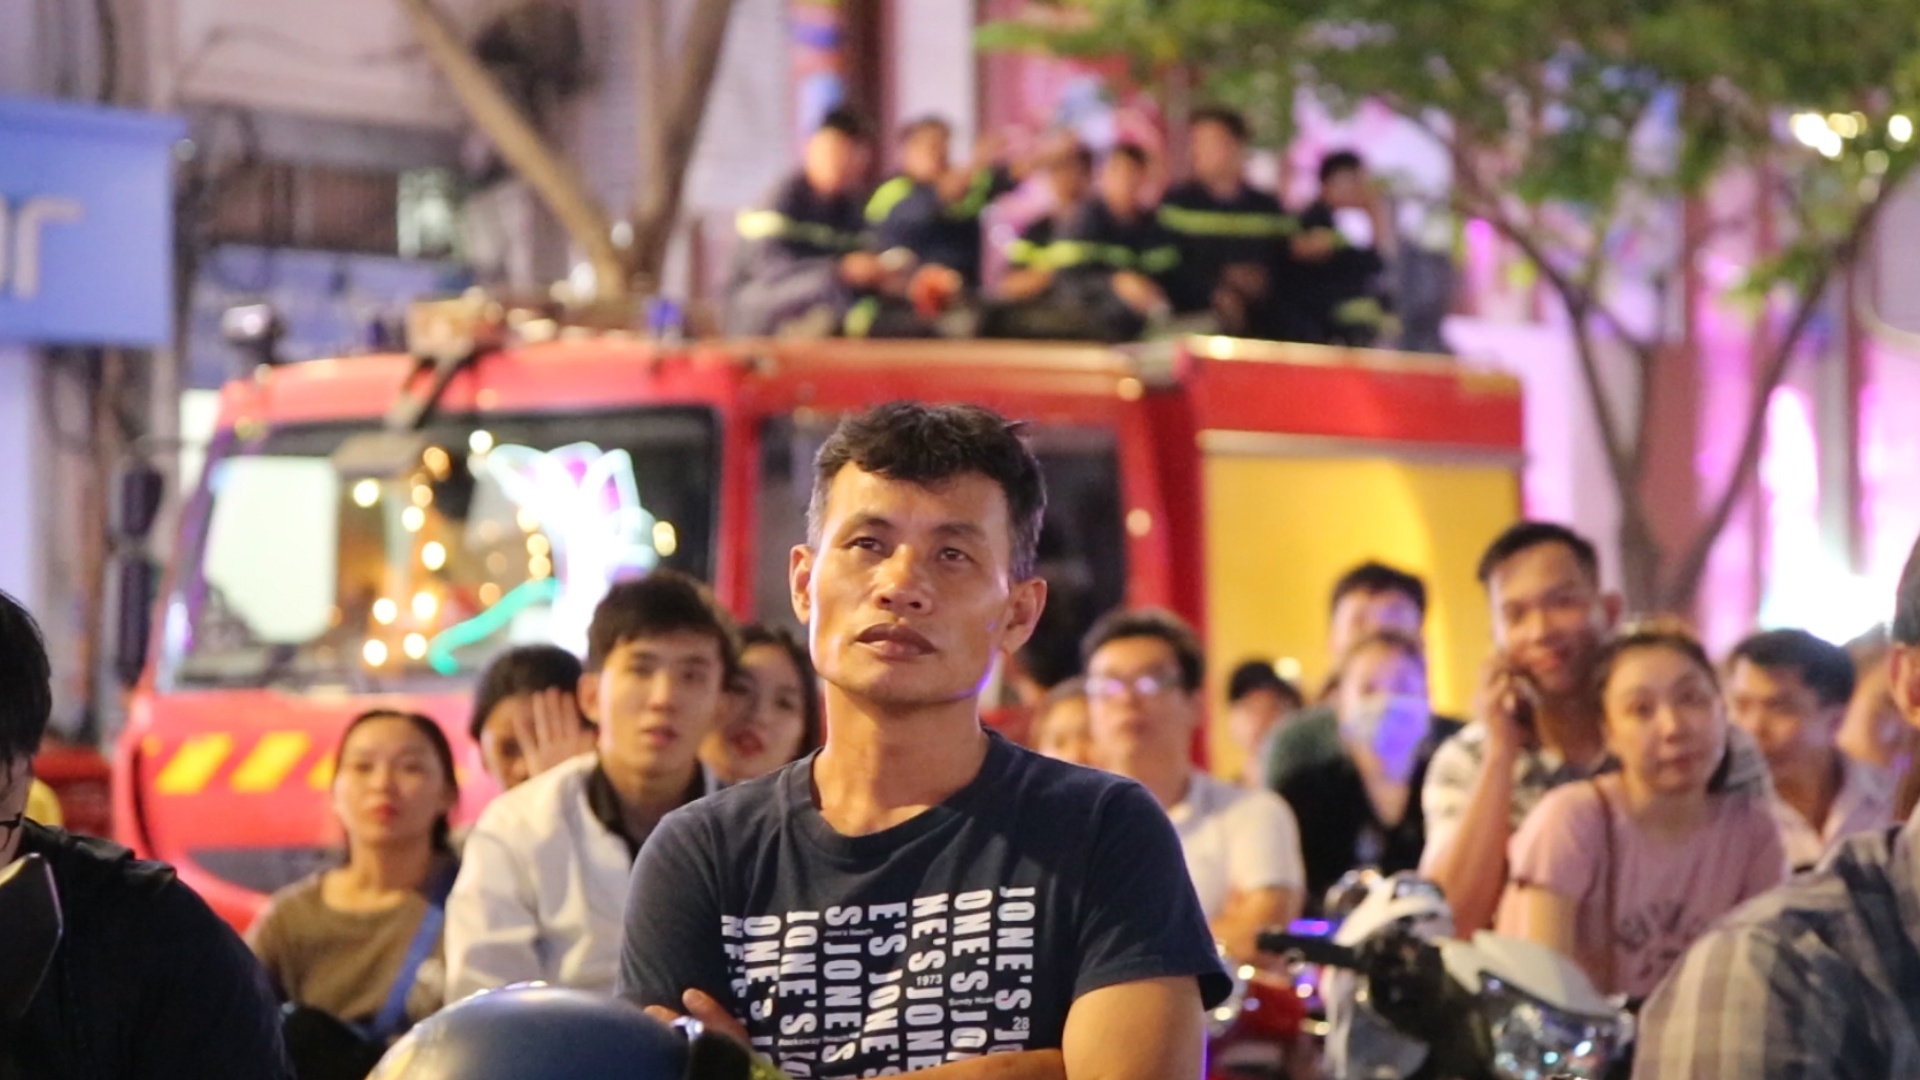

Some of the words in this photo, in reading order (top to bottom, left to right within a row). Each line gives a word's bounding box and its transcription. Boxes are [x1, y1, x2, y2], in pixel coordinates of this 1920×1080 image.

[0, 192, 86, 300] r
[868, 902, 908, 956] E'S
[908, 893, 949, 973] NE'S
[950, 889, 993, 993] ONE'S
[994, 886, 1036, 1010] JONE'S
[916, 974, 942, 986] 1973
[1012, 1016, 1030, 1030] 28
